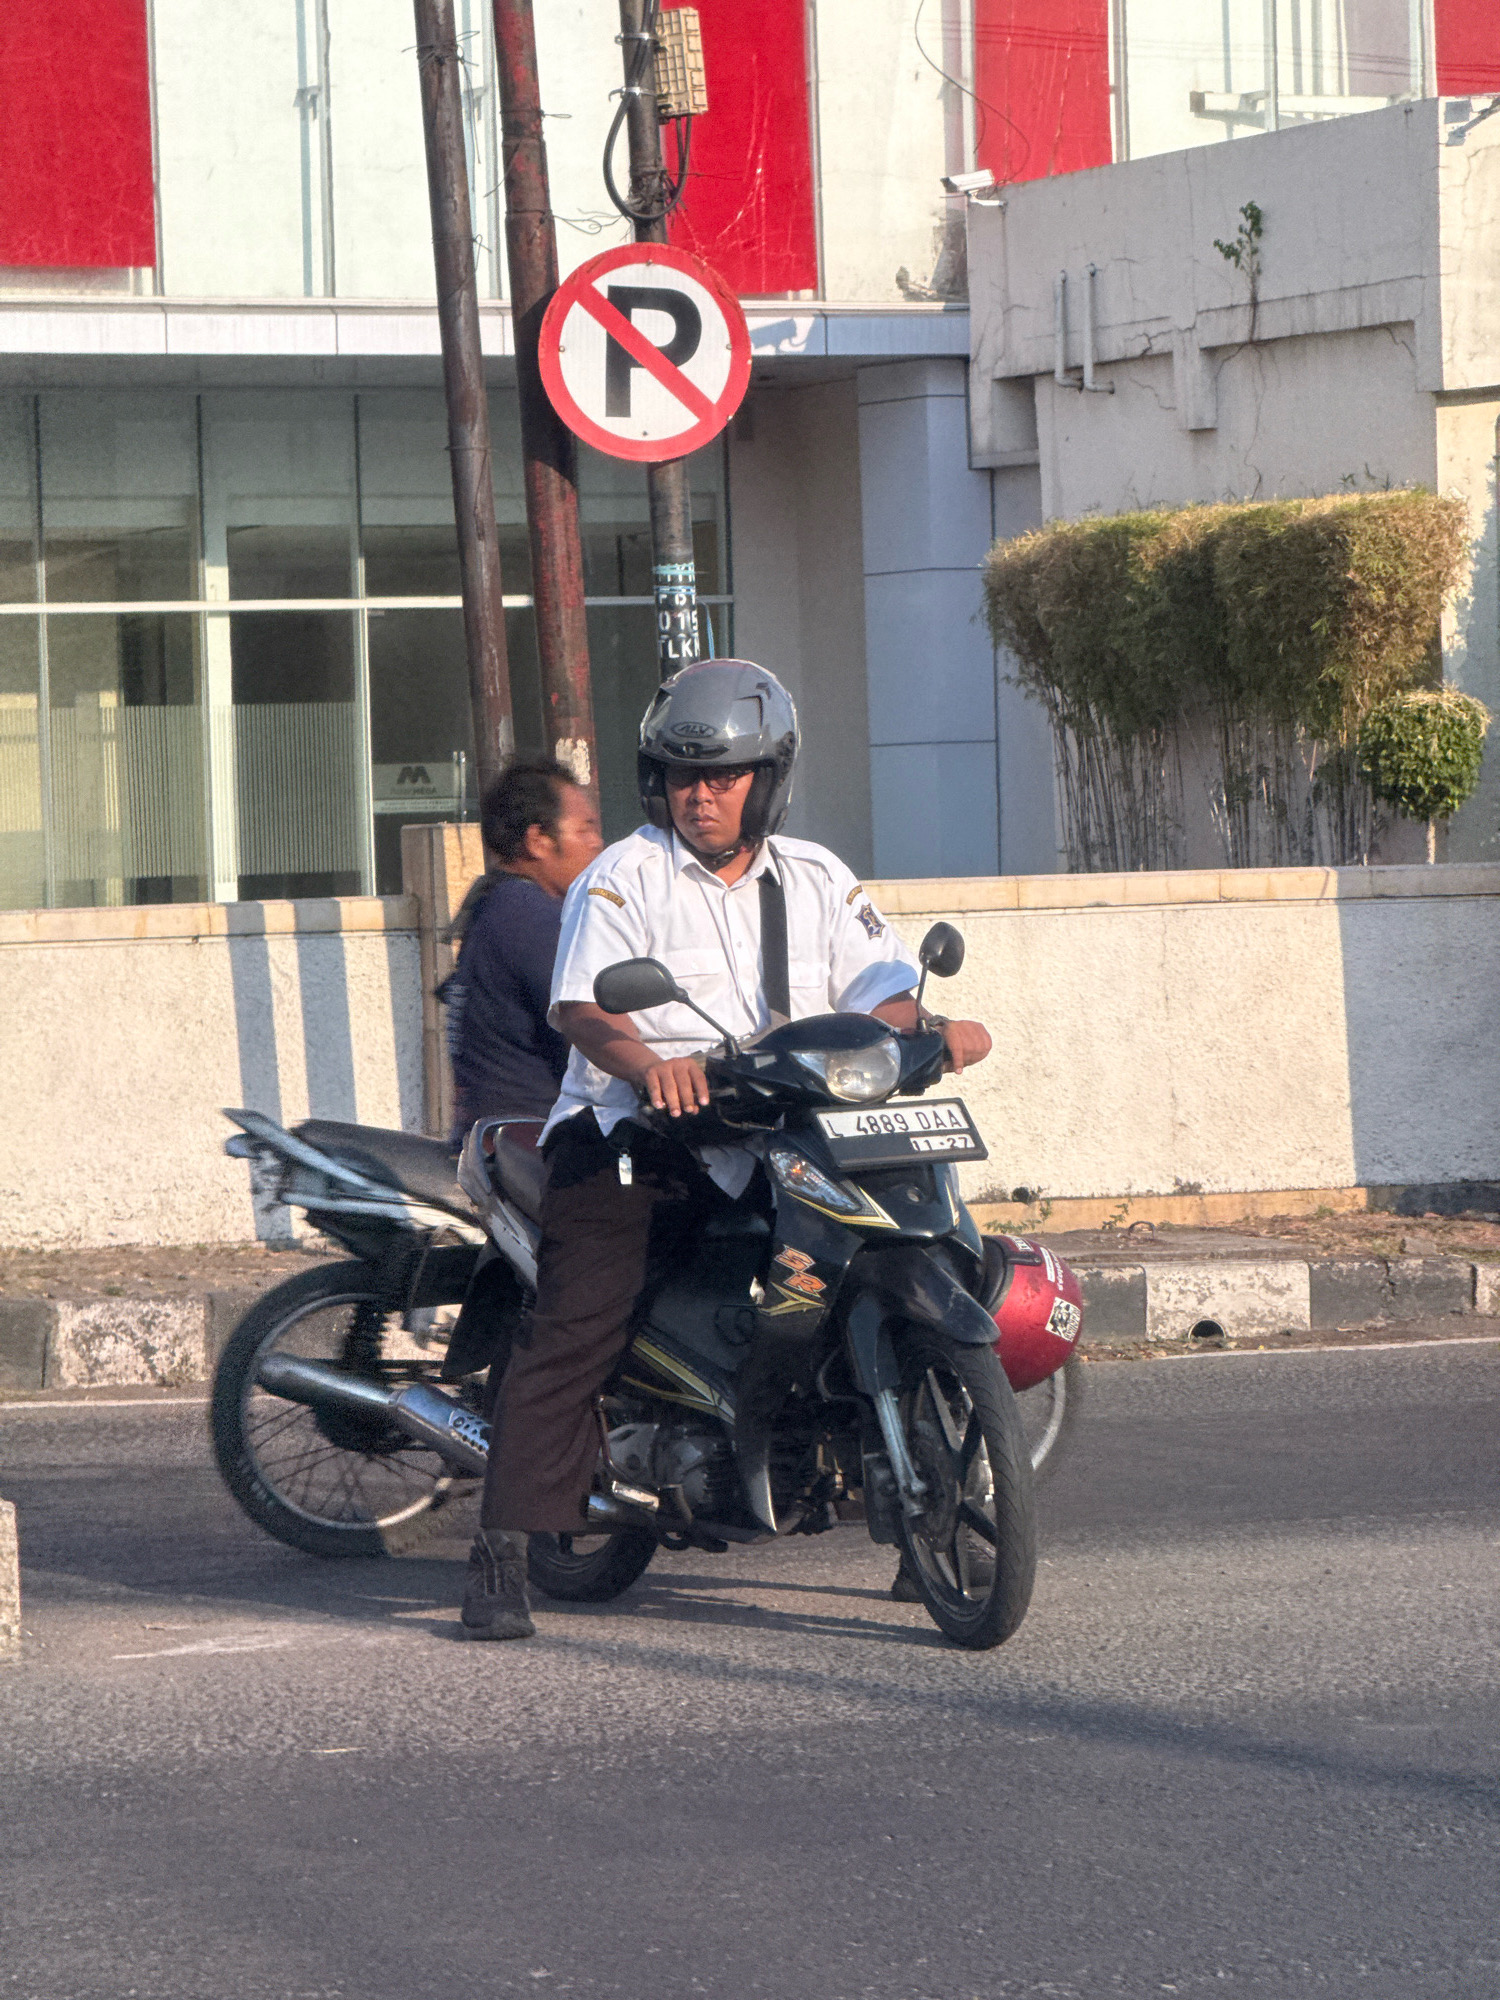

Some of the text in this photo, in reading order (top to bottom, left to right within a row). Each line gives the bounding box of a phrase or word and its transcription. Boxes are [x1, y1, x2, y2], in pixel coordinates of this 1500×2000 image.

[605, 285, 702, 418] P
[826, 1108, 963, 1138] L 4889 DAA
